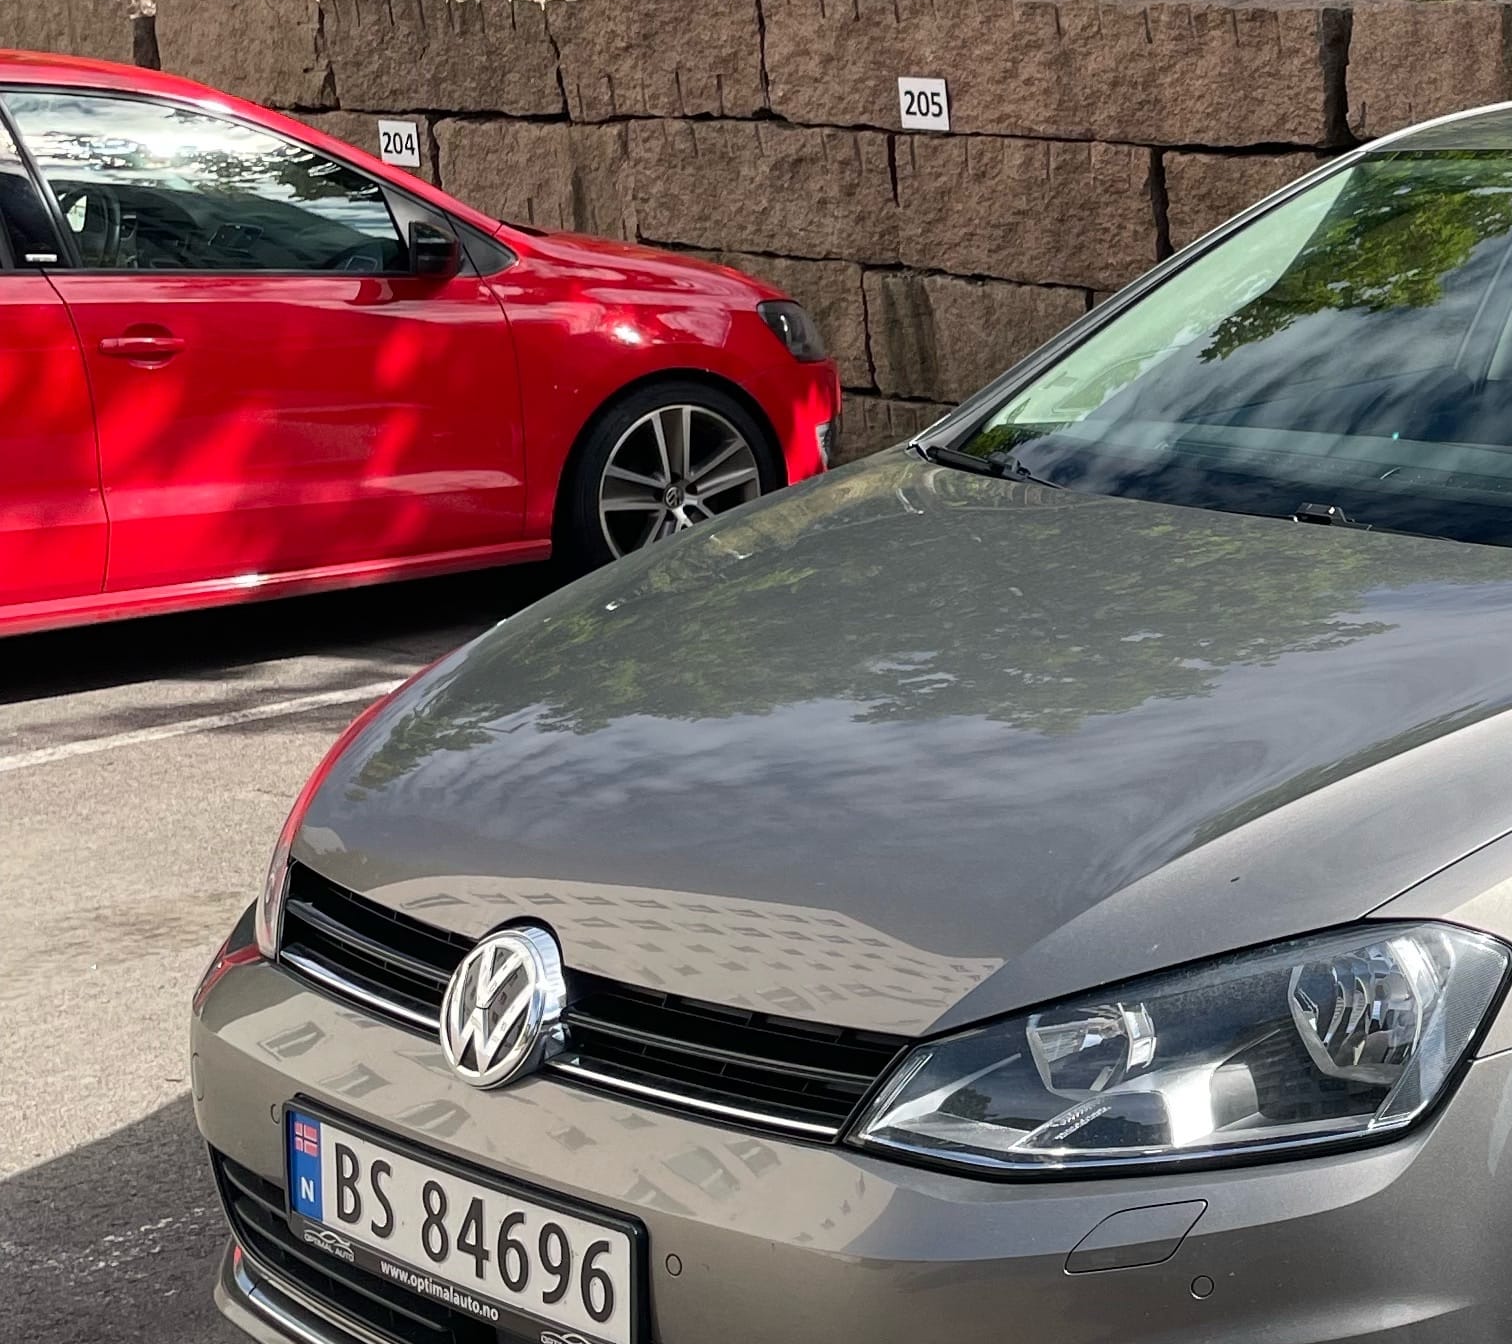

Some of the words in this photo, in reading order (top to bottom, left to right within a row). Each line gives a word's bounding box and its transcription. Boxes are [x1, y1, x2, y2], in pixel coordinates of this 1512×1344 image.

[903, 90, 943, 117] 205
[382, 131, 416, 156] 204
[301, 1176, 315, 1204] N
[334, 1142, 394, 1239] BS
[421, 1179, 614, 1323] 84696
[335, 1247, 355, 1263] AUTO
[380, 1260, 499, 1321] www.optimalauto.no
